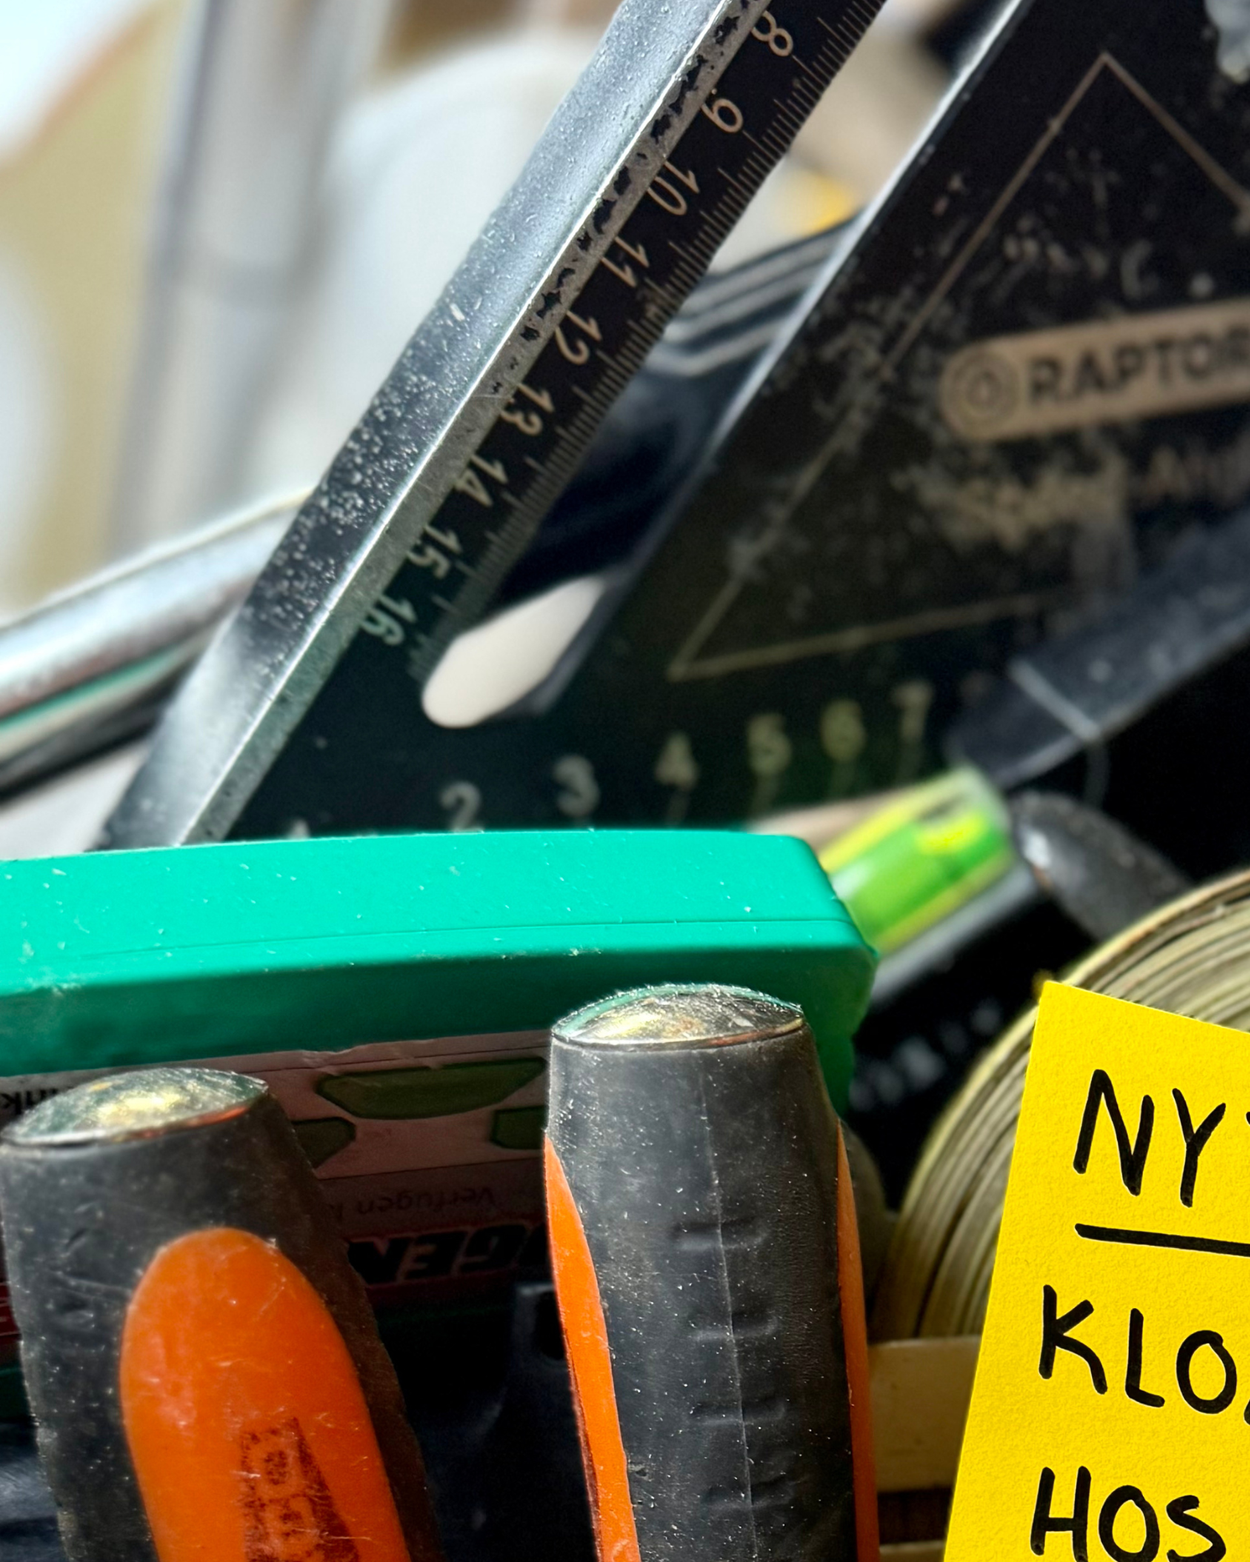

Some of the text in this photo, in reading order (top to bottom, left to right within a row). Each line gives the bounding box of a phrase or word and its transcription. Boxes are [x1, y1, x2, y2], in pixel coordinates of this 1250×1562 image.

[359, 9, 793, 645] 8 9 10 11 12 13 14 15 16
